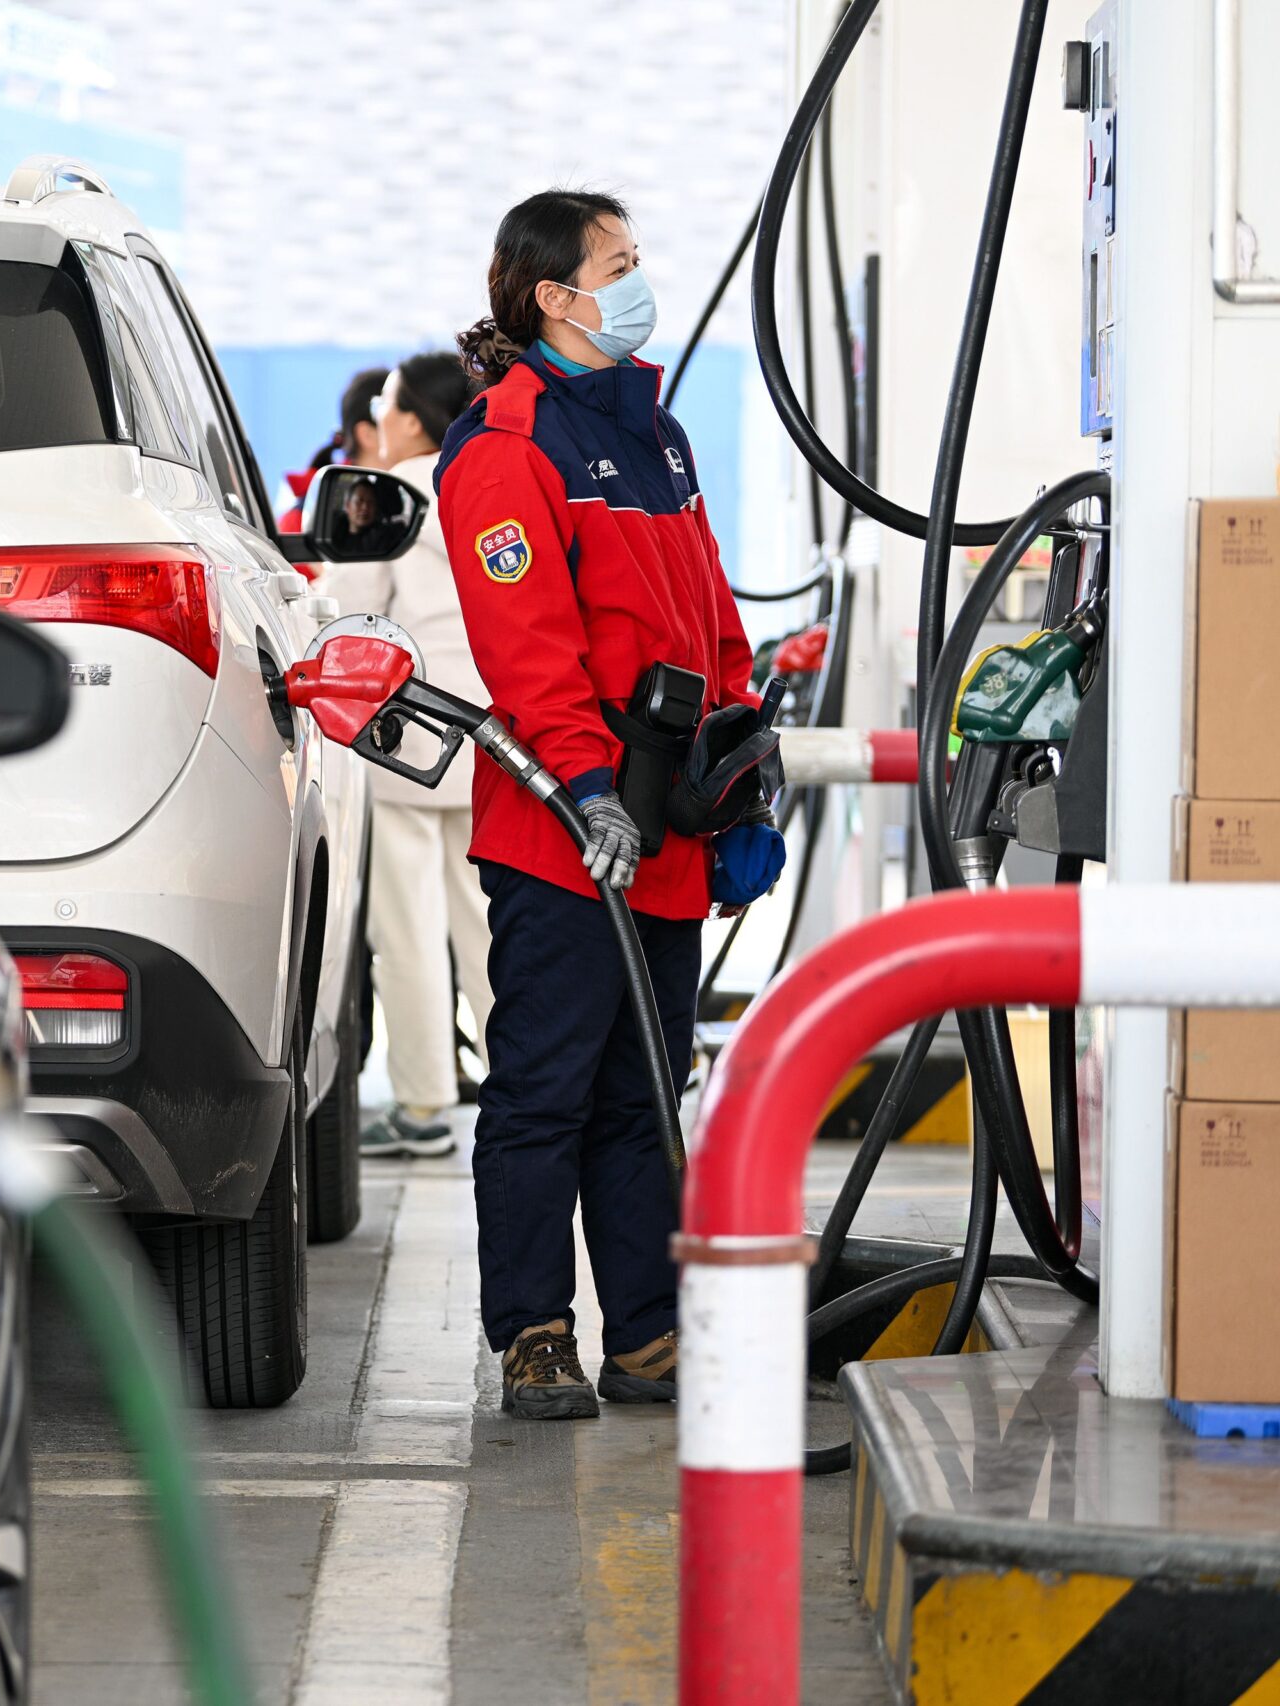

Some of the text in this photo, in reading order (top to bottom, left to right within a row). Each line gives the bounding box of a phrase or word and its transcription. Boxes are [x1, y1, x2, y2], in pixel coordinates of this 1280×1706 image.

[483, 528, 517, 552] 安全员
[68, 663, 111, 686] 五菱
